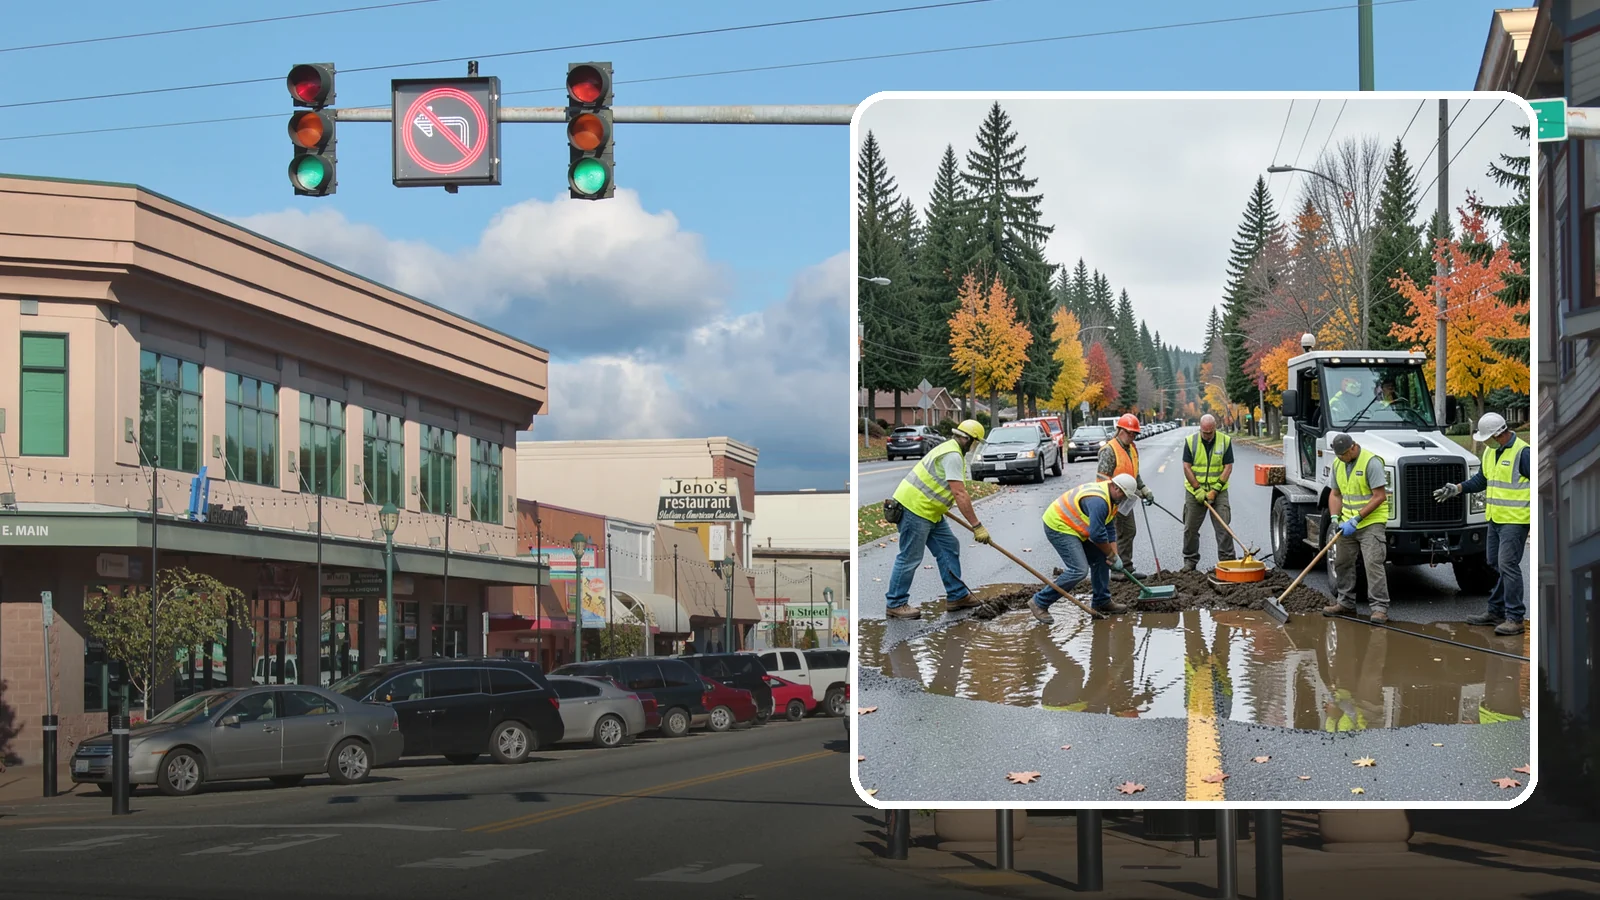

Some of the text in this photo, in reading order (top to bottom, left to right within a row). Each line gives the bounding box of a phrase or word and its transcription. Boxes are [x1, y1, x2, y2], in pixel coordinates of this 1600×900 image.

[670, 480, 727, 494] Jeno's
[665, 496, 731, 509] restaurant
[658, 510, 681, 519] Italian
[686, 510, 714, 519] American
[715, 510, 737, 519] Cuisine
[2, 525, 49, 536] E. MAIN
[797, 607, 828, 617] Street
